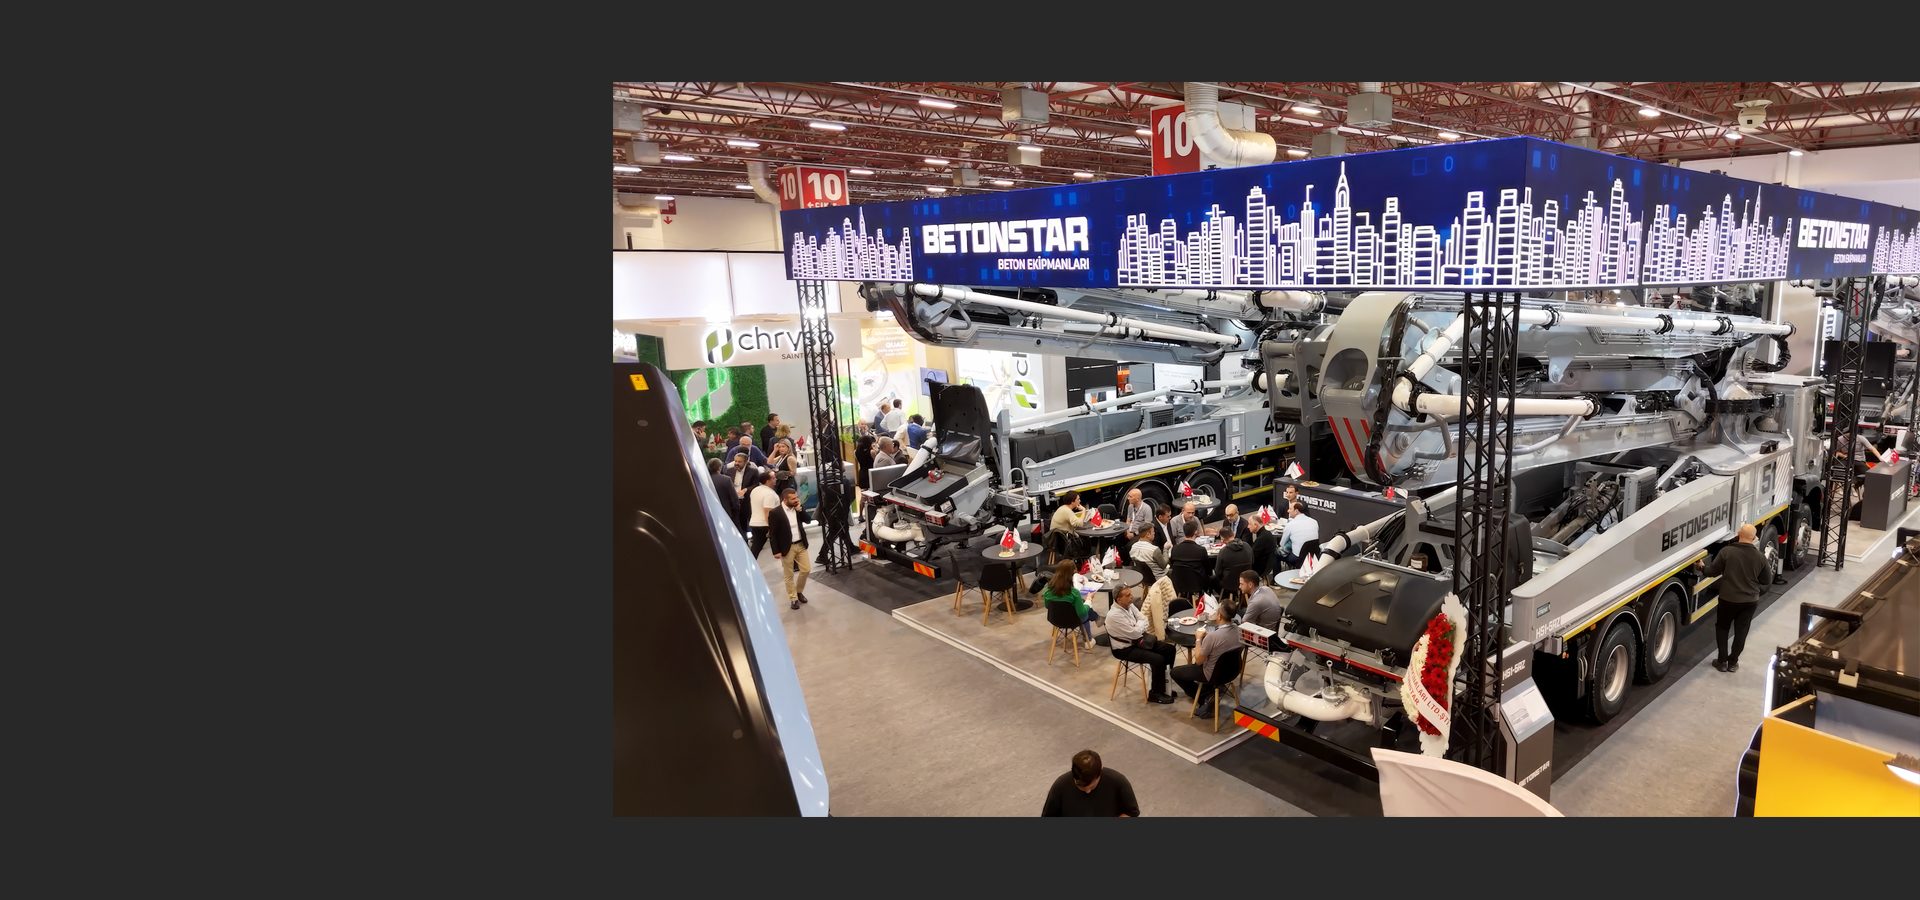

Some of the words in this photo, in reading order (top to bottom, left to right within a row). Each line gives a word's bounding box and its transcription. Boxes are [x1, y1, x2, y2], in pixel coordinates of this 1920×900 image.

[1158, 111, 1194, 159] 10
[781, 172, 797, 201] 10
[807, 172, 842, 201] 10
[922, 216, 1089, 254] BETONSTAR
[1797, 217, 1870, 249] BETONSTAR
[998, 259, 1026, 270] BETON
[1027, 256, 1090, 270] EKİPMANLARI
[738, 326, 835, 351] chryso
[1124, 433, 1217, 462] BETONSTAR
[1661, 502, 1729, 552] BETONSTAR
